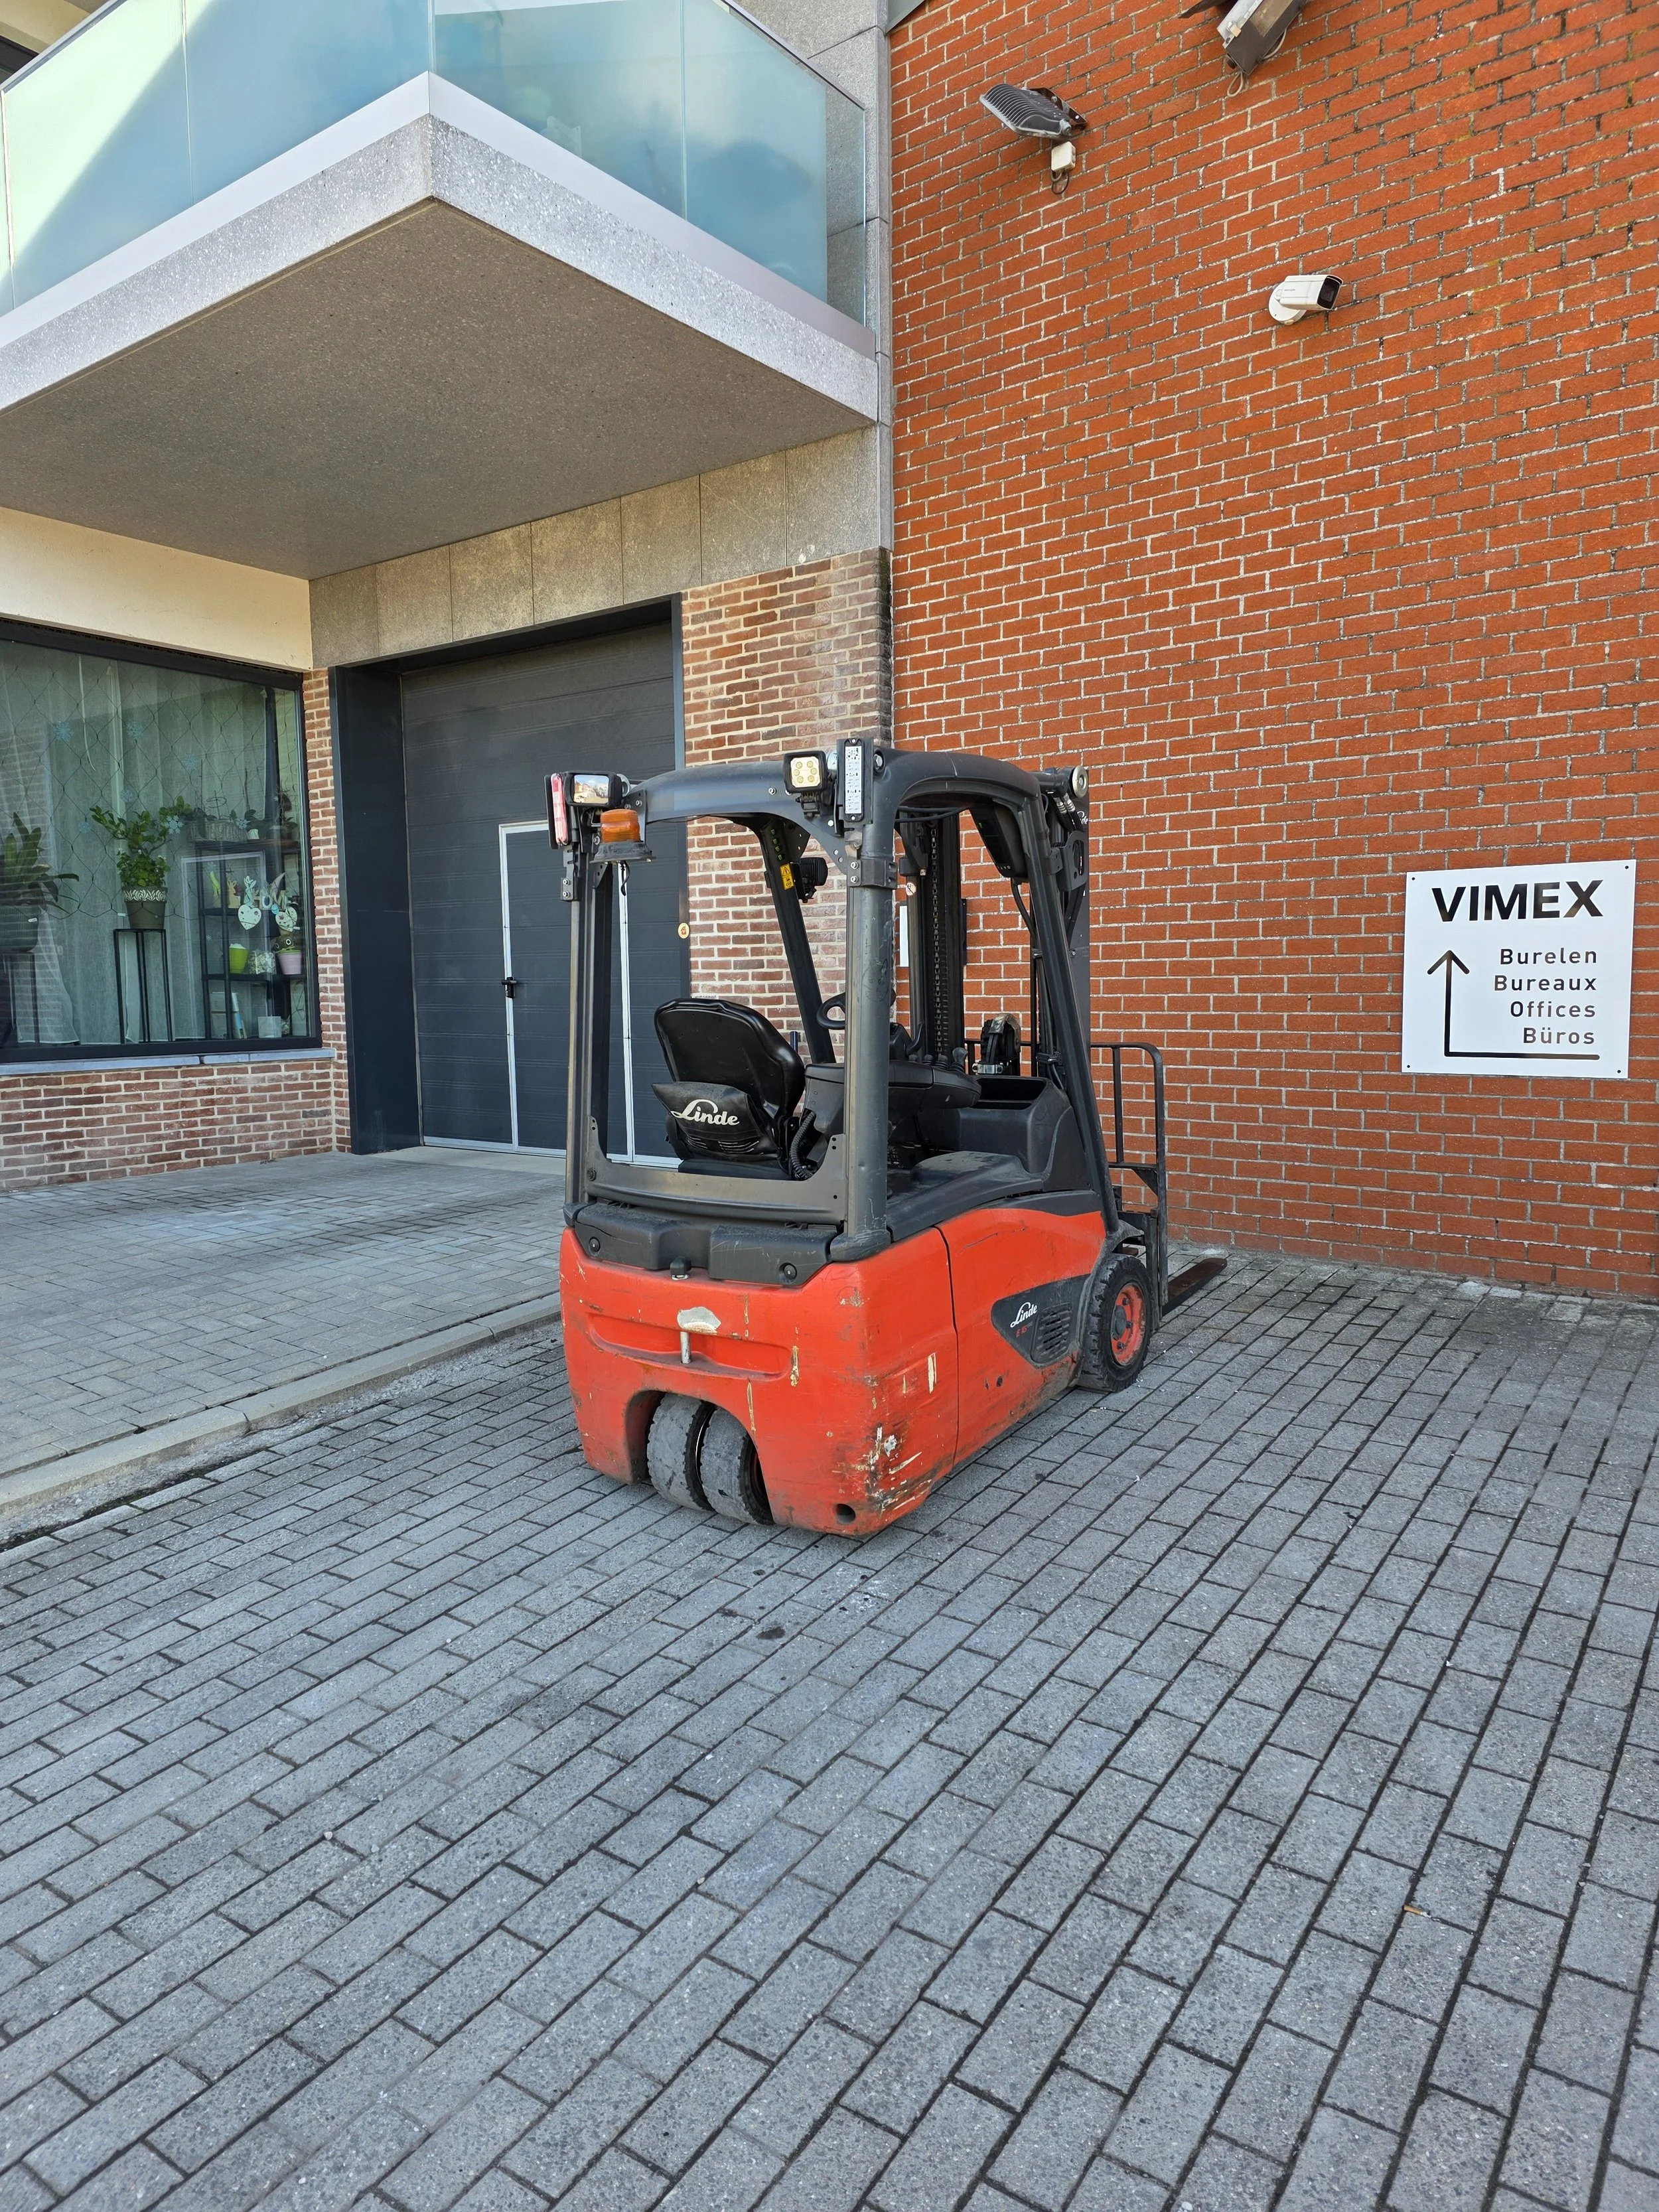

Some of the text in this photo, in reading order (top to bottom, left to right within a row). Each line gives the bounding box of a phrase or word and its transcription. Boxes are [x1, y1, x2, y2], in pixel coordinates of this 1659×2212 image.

[1431, 880, 1603, 922] VIMEX
[1500, 948, 1596, 964] Burelen
[1494, 976, 1596, 991] Bureaux
[1511, 1001, 1595, 1017] Offices
[1524, 1027, 1594, 1044] Büros
[670, 1098, 740, 1126] Linde
[1010, 1301, 1038, 1328] Linde
